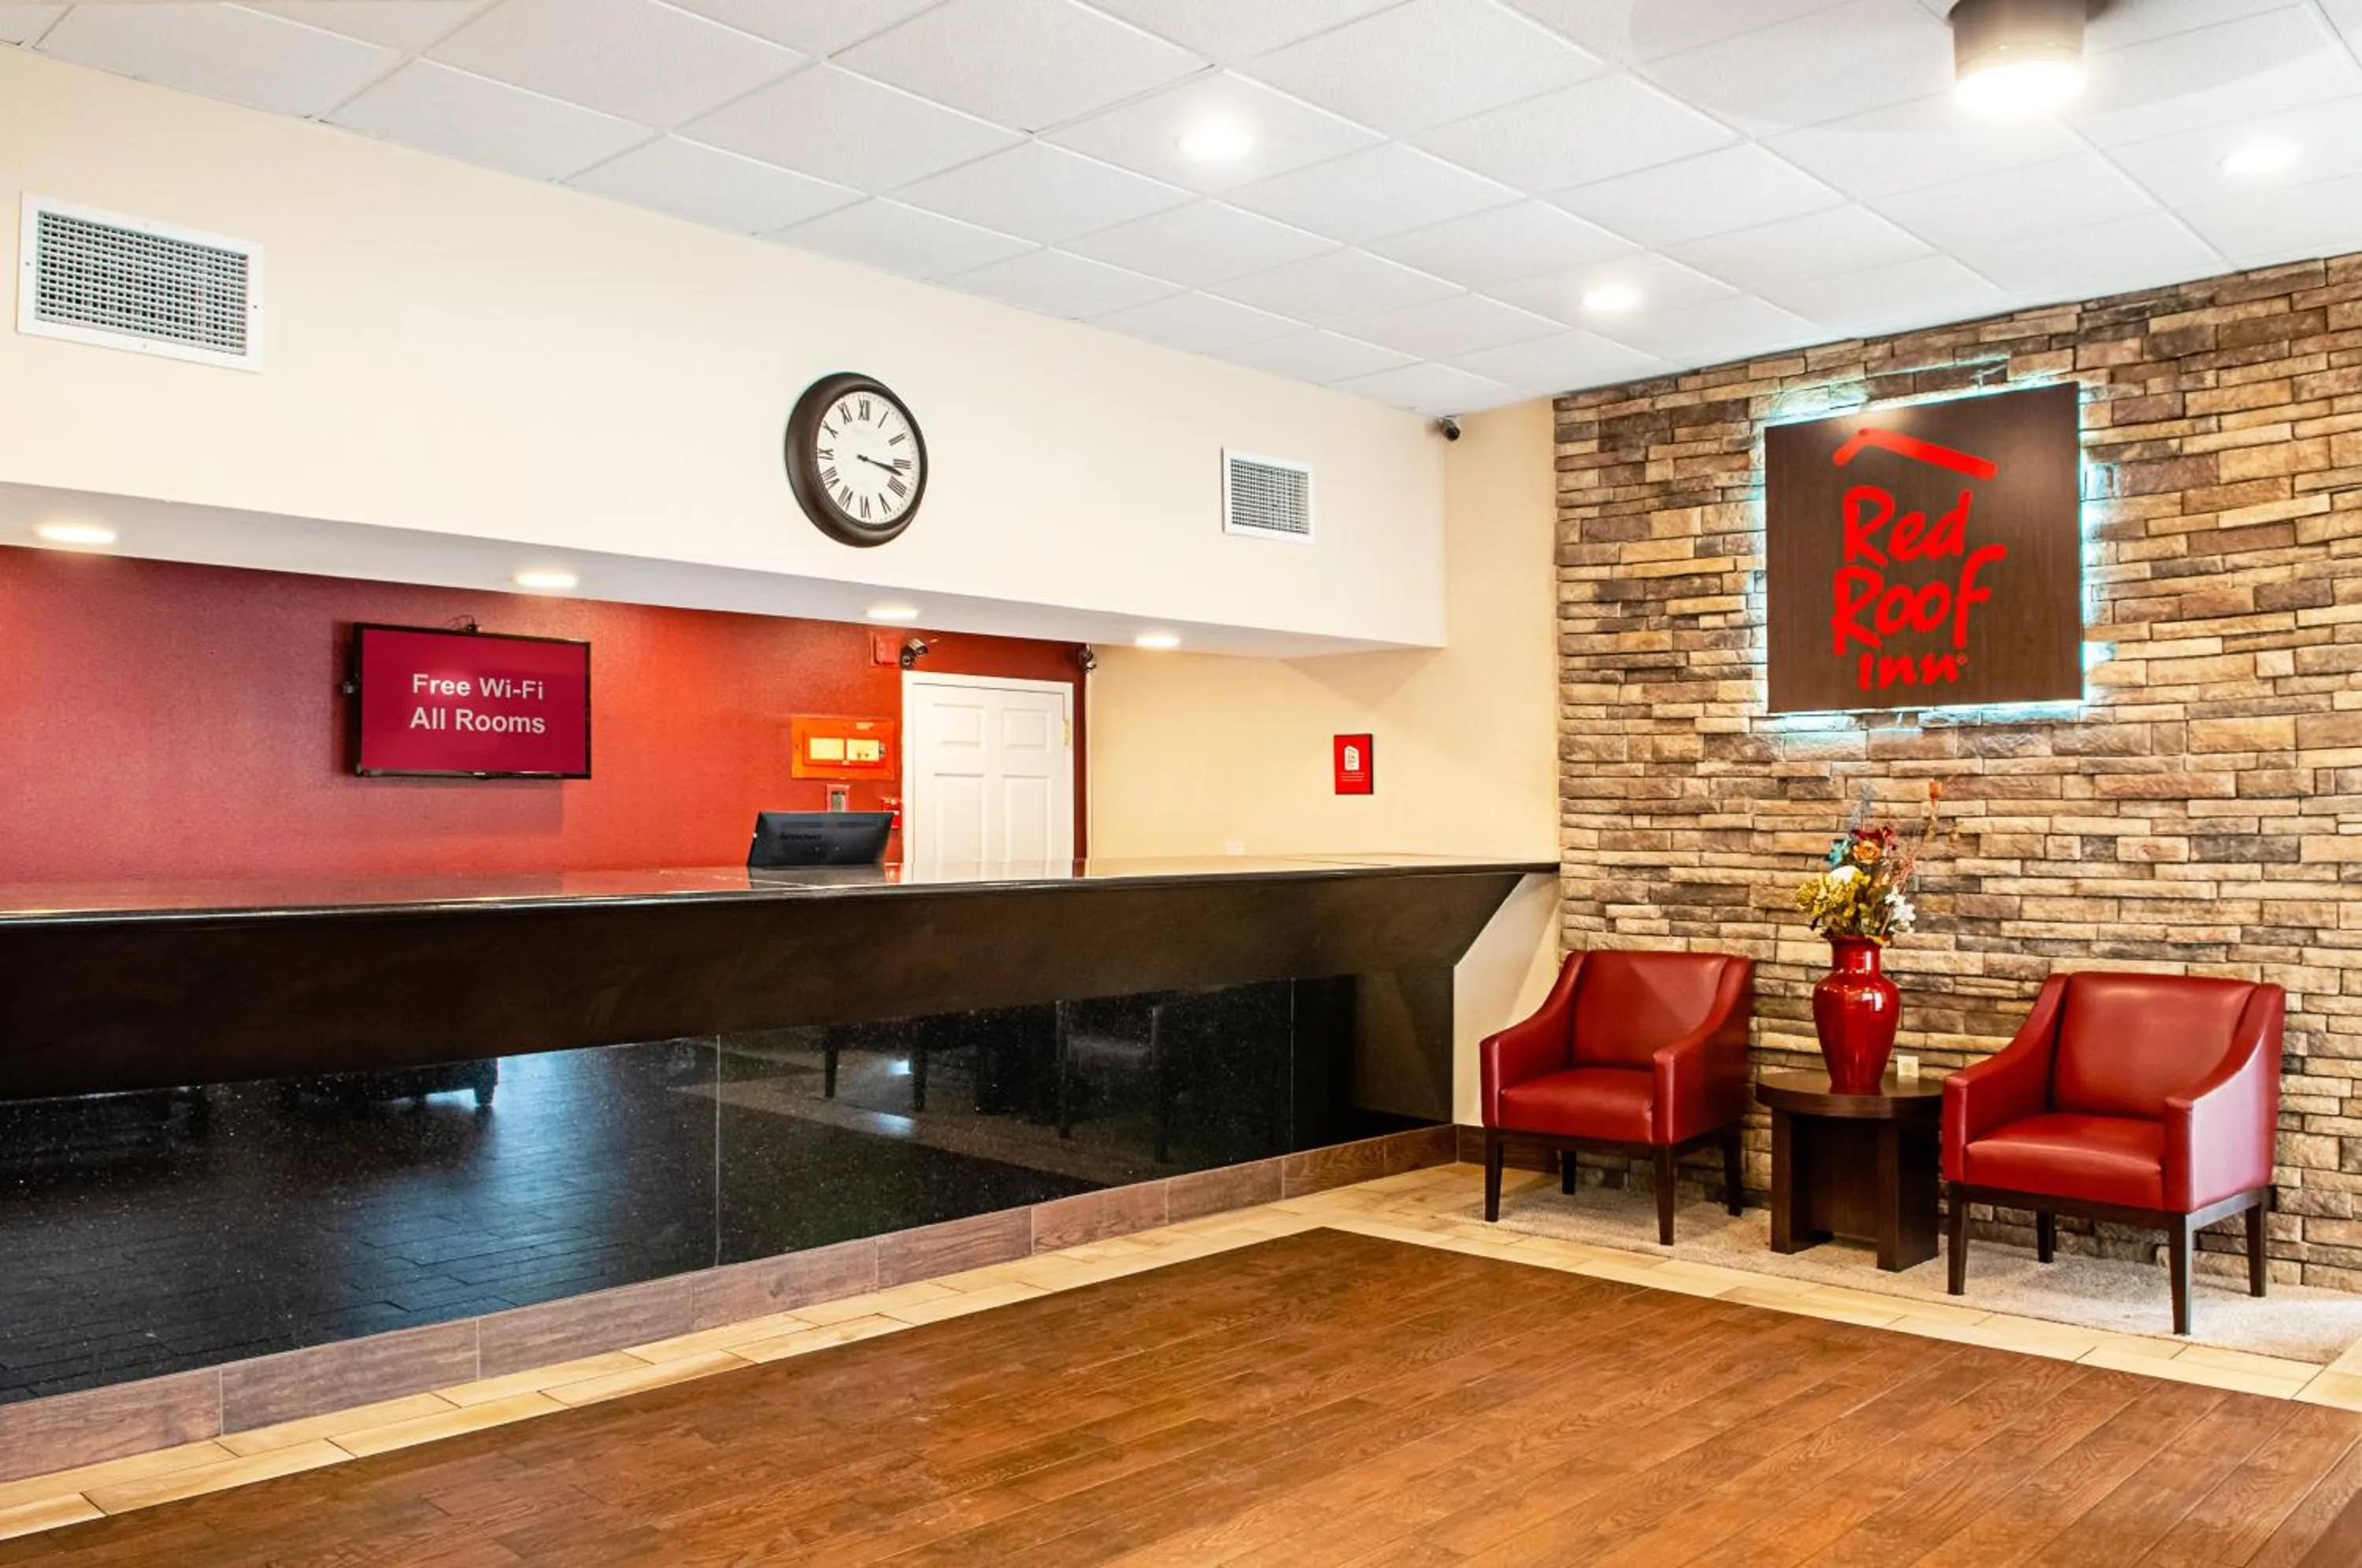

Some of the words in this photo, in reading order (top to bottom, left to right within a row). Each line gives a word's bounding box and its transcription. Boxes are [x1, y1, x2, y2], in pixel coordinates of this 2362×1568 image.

[837, 402, 853, 425] XI
[857, 399, 872, 421] XII
[878, 410, 890, 429] I
[821, 420, 839, 438] X
[888, 433, 906, 446] II
[817, 448, 835, 460] IX
[893, 458, 912, 470] III
[859, 494, 872, 520] VI
[878, 492, 893, 515] V
[1842, 484, 1974, 567] Red
[1830, 543, 2008, 656] Roof
[413, 673, 472, 697] Free
[479, 677, 543, 700] Wi-Fi
[409, 707, 446, 730] All
[456, 708, 546, 734] Rooms
